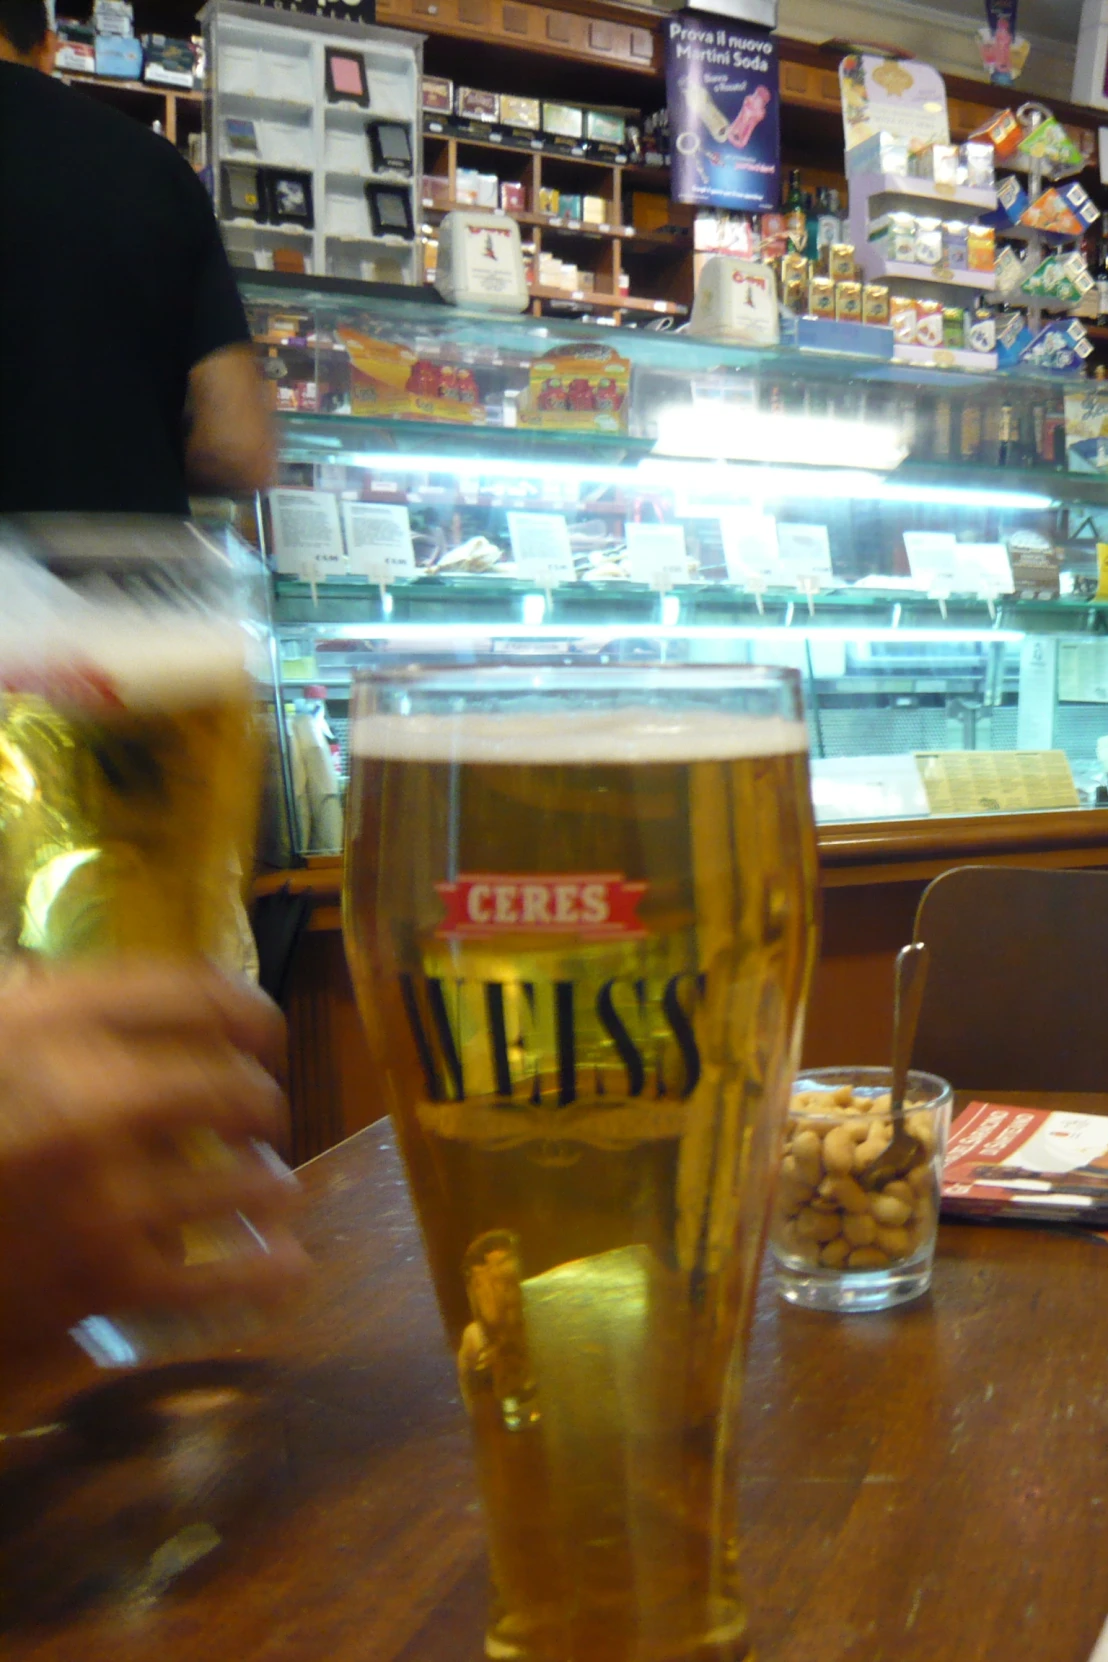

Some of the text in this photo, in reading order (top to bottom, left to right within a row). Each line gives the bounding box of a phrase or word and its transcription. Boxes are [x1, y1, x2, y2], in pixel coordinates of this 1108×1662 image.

[669, 22, 773, 54] Prova il nuovo
[676, 43, 769, 73] Martini Soda
[467, 884, 611, 924] CERES
